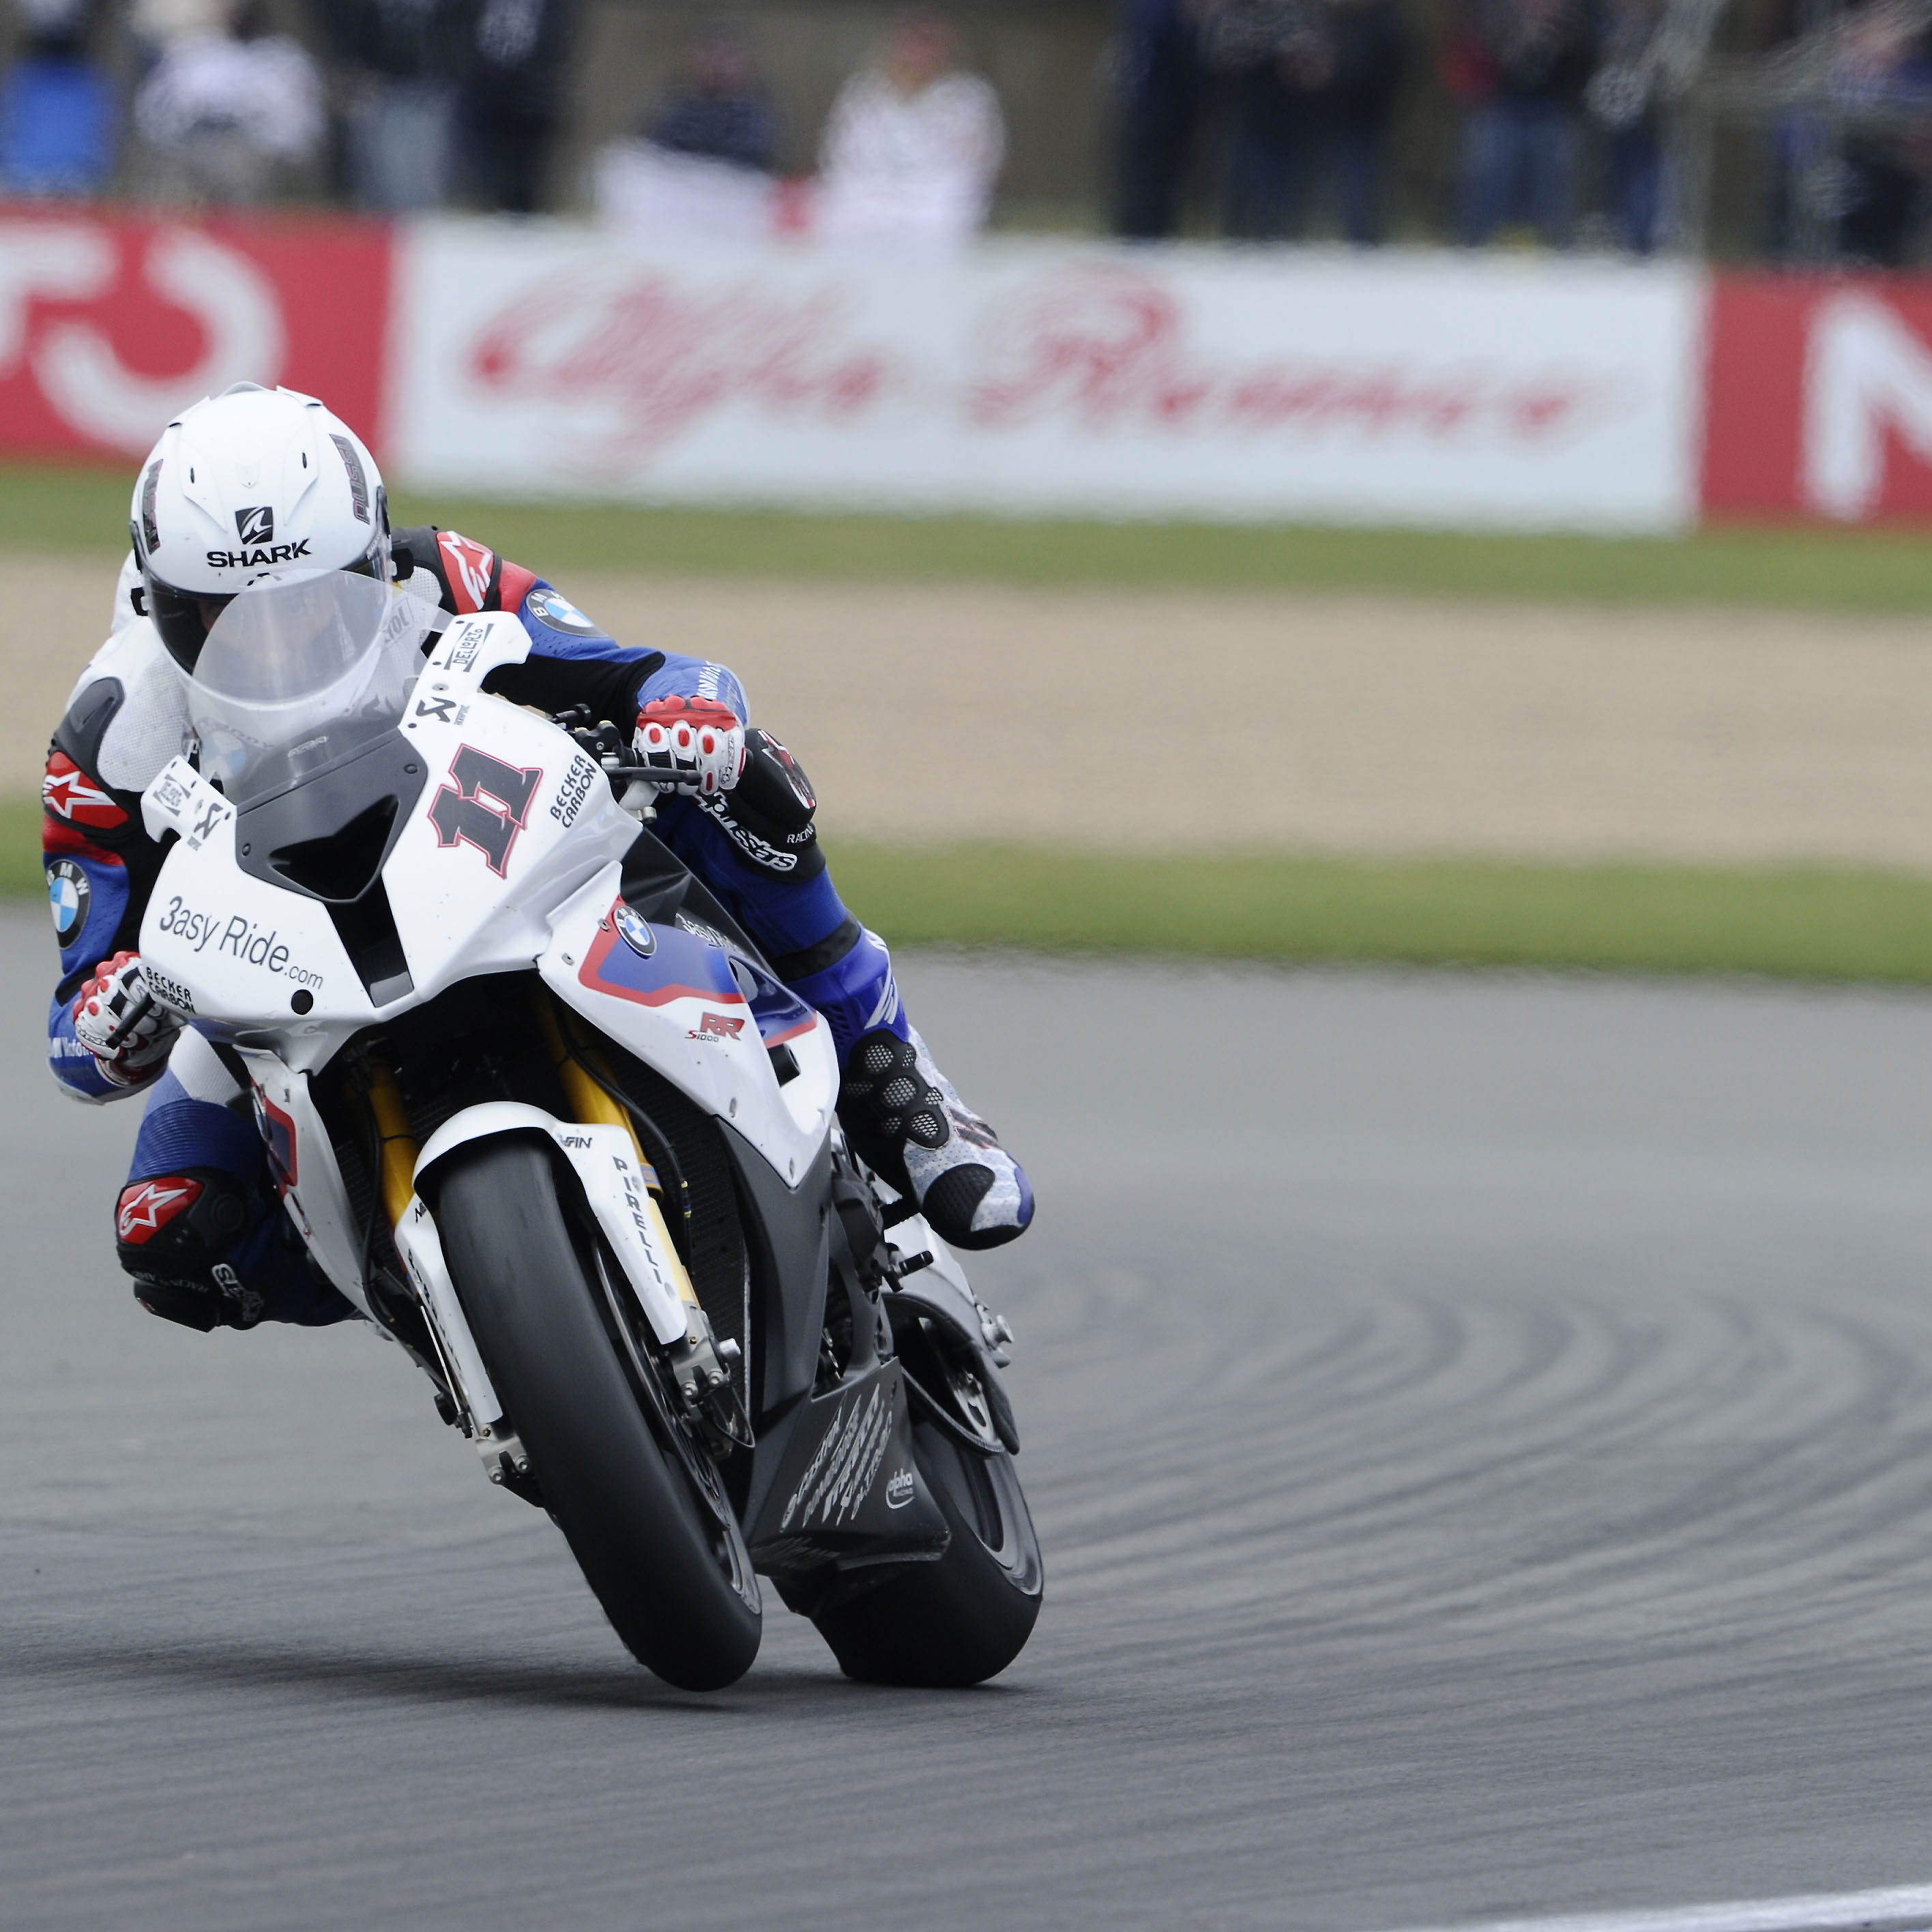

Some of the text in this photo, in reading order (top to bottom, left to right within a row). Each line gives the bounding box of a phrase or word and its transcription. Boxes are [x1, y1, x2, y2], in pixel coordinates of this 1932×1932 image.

[207, 538, 312, 568] SHARK
[427, 743, 543, 879] 11
[550, 755, 586, 820] BECKER
[562, 762, 597, 828] CARBON
[46, 862, 89, 896] BMW
[160, 896, 323, 990] 3asy Ride.com
[146, 967, 192, 1002] BECKER
[149, 981, 196, 1014] CARBON
[684, 1012, 745, 1042] S1000 RR
[612, 1156, 663, 1285] PIRELLI
